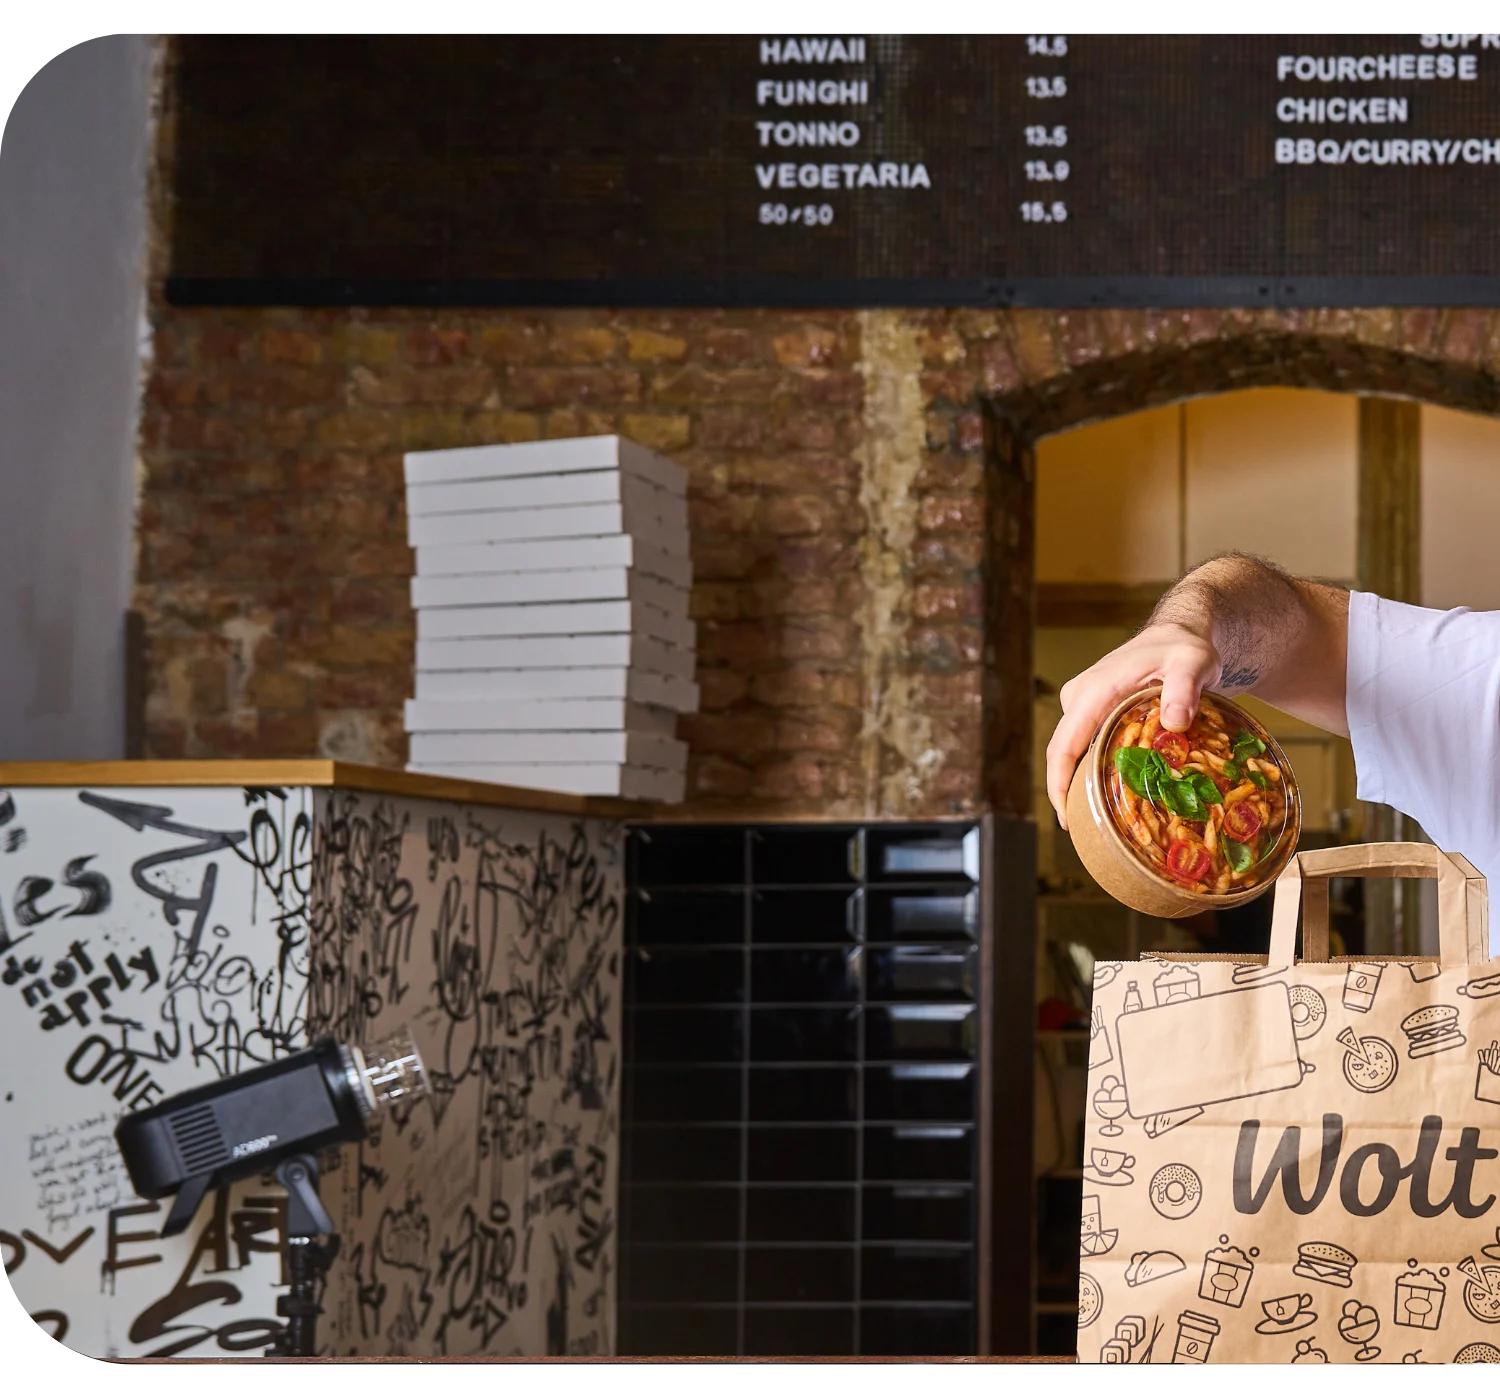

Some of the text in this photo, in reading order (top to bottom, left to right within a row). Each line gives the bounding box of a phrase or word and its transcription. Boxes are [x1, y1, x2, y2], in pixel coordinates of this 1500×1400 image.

[760, 38, 866, 65] HAWAII
[1277, 54, 1478, 82] FOURCHEESE
[756, 79, 869, 107] FUNGHI
[1276, 96, 1408, 124] CHICKEN
[755, 120, 860, 147] TONNO
[755, 161, 932, 190] VEGETARIA
[1232, 1112, 1499, 1219] Wolt
